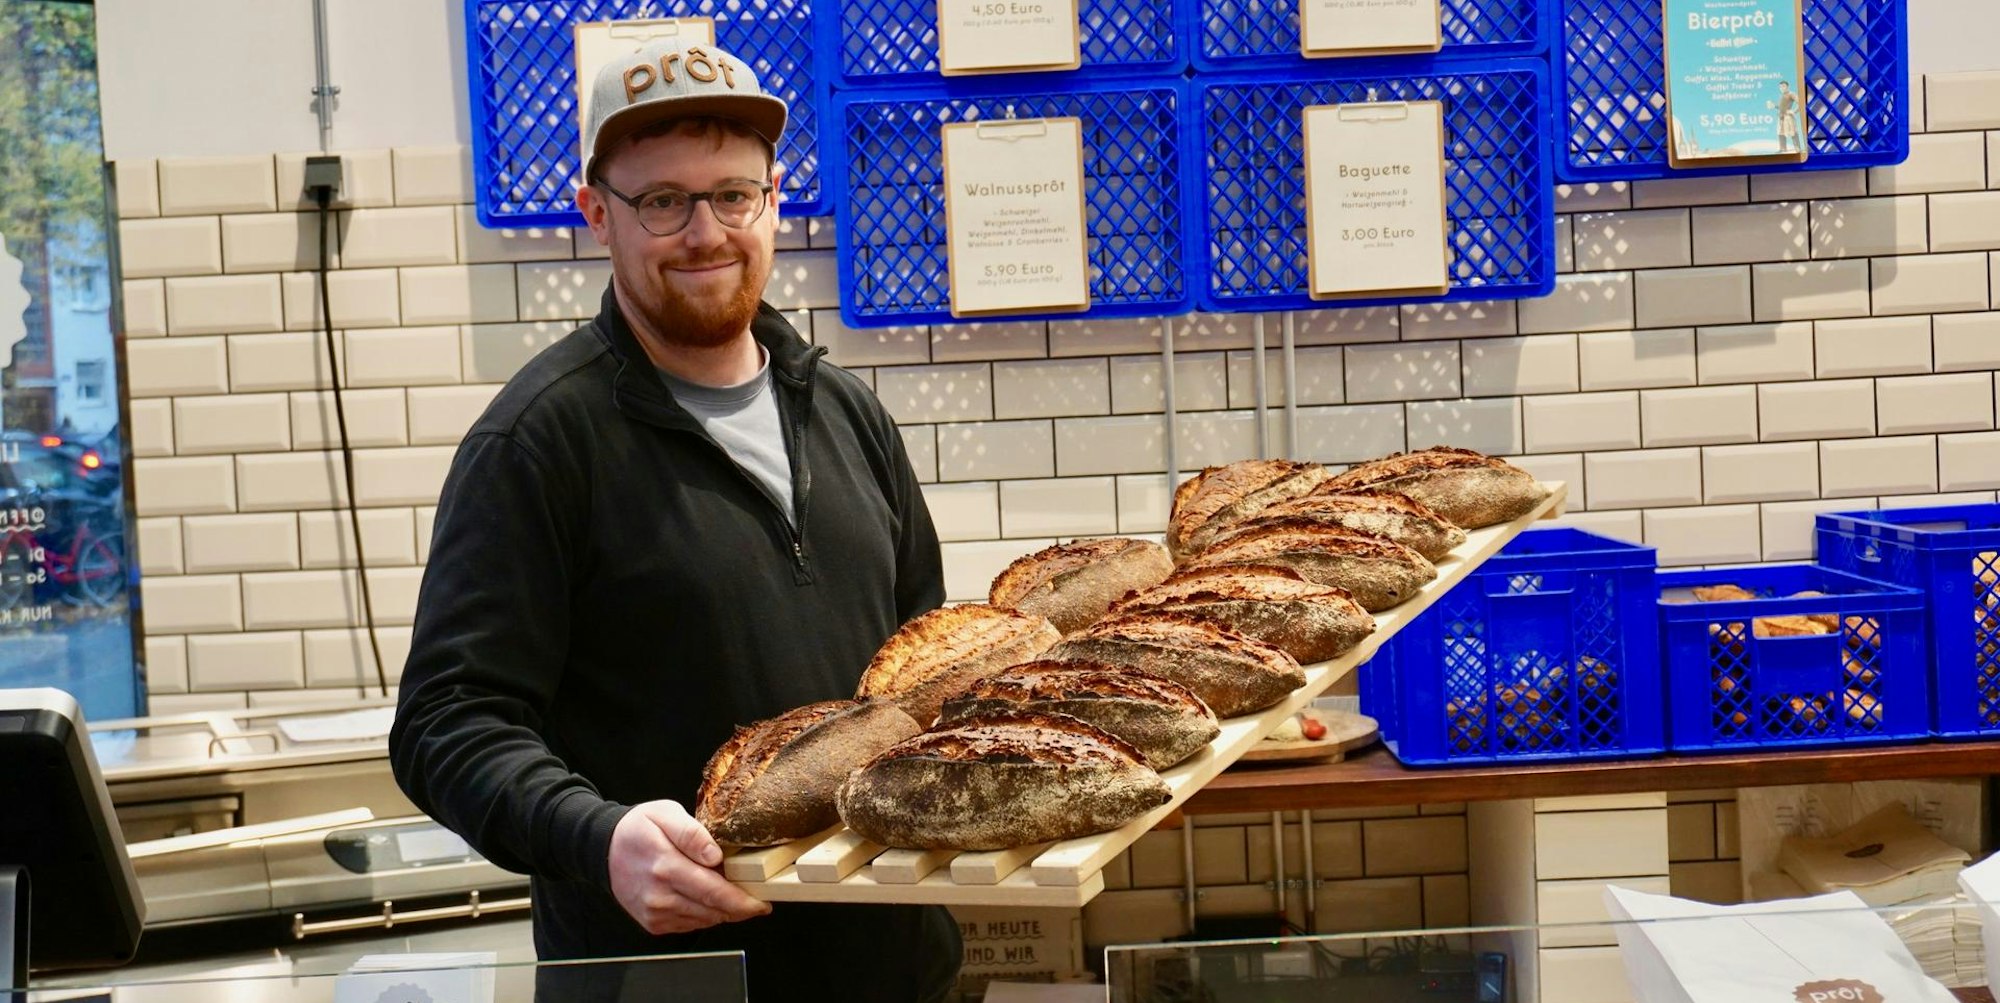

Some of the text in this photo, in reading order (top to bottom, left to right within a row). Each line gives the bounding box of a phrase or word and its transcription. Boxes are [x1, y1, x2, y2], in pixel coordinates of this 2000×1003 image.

[972, 2, 1043, 16] 4,50 Euro
[1688, 10, 1774, 34] Bierprôt
[623, 47, 735, 104] prôt
[1700, 112, 1773, 127] 5,90 Euro
[1339, 164, 1411, 181] Baguette
[964, 180, 1065, 197] Walnussprôt
[1342, 227, 1415, 241] 3,00 Euro
[984, 263, 1054, 277] 5,90 Euro
[988, 920, 1041, 936] HEUTE
[967, 946, 1034, 961] IND WIR
